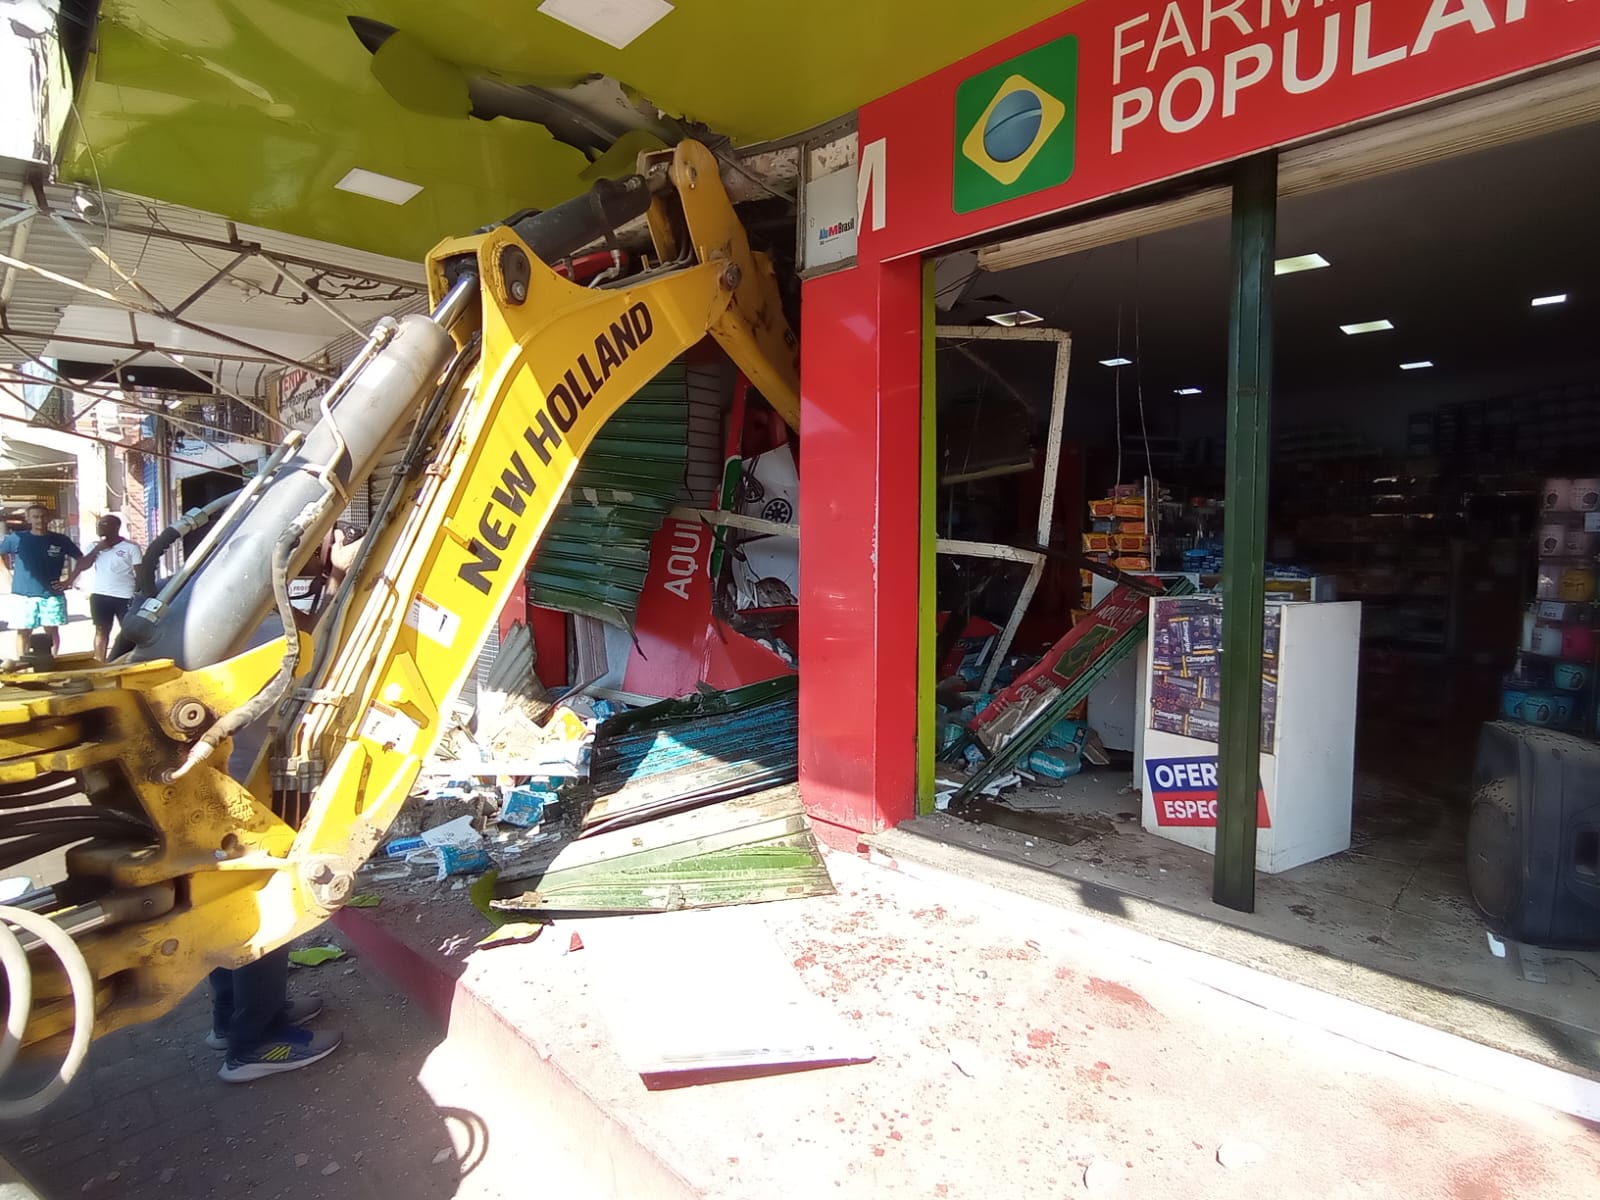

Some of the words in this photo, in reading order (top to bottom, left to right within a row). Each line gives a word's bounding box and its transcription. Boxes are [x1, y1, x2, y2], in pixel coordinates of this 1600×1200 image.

[457, 450, 537, 596] NEW
[523, 301, 653, 466] HOLLAND
[664, 522, 702, 600] AQUI
[1155, 763, 1218, 788] OFER
